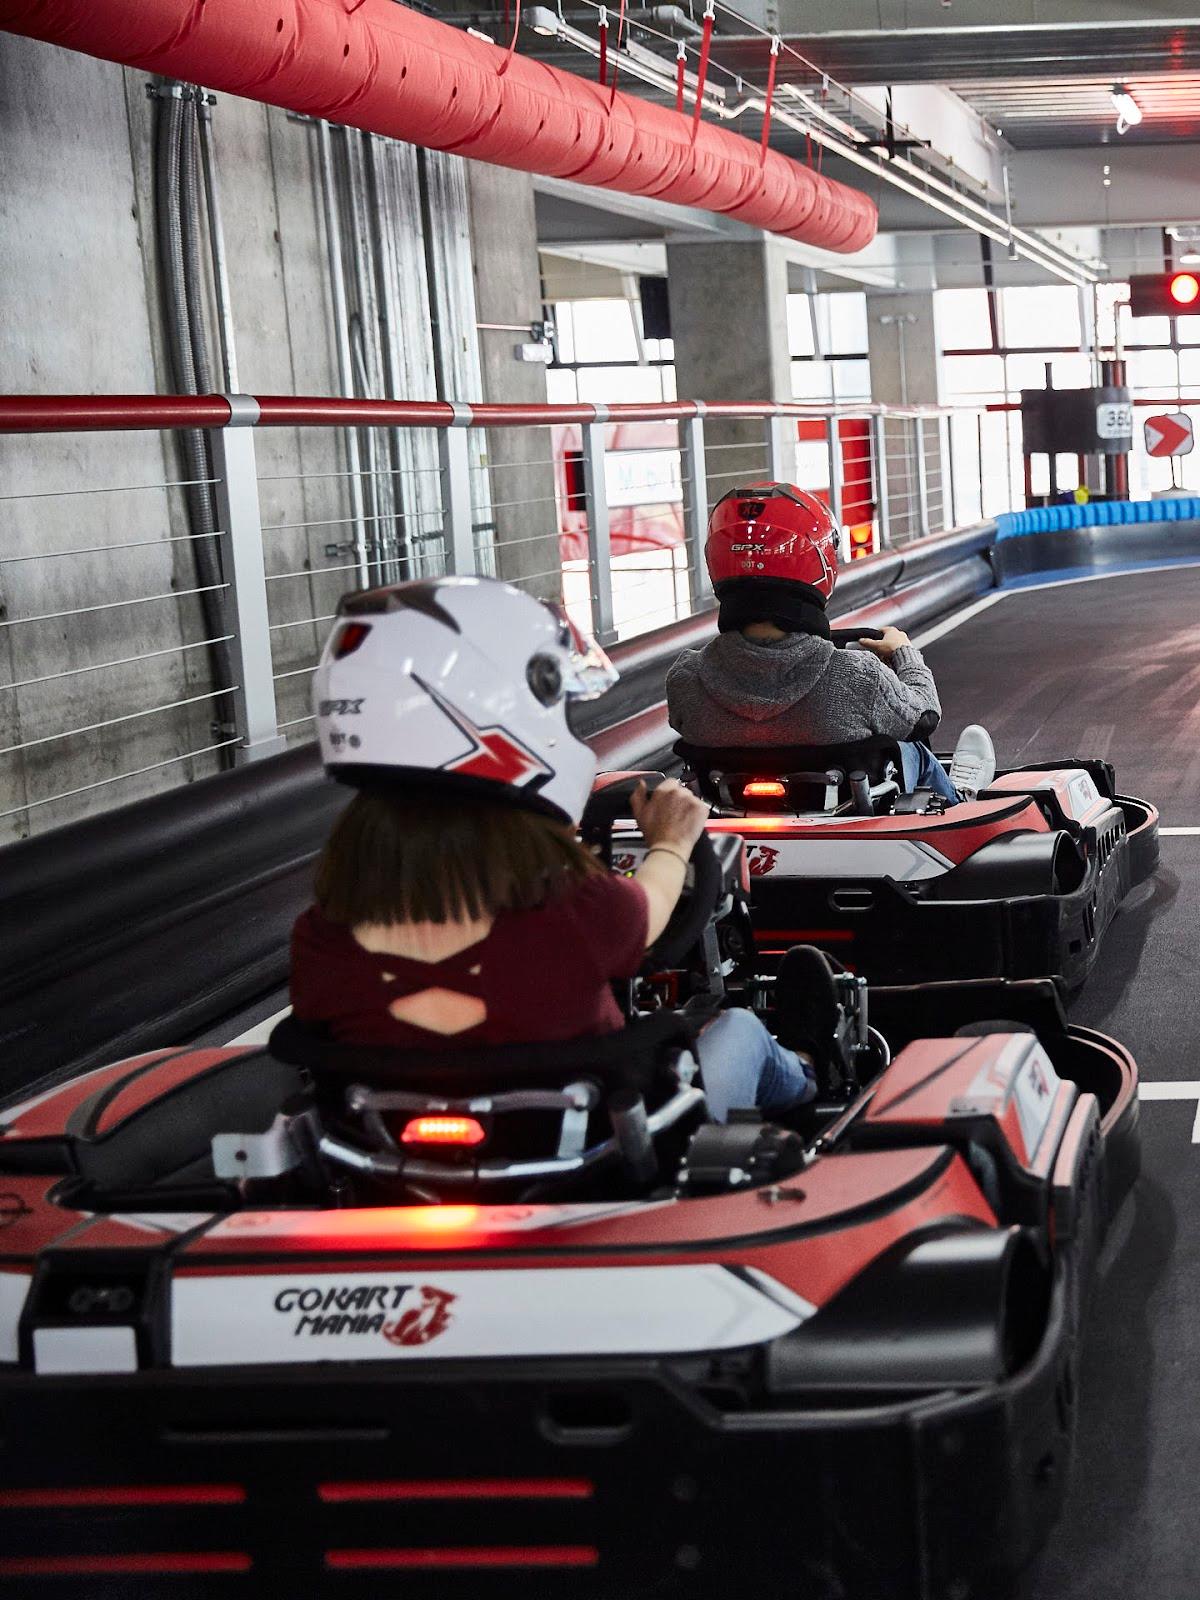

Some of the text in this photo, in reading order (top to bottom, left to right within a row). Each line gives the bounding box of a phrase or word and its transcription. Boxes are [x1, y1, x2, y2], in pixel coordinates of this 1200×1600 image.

[730, 543, 764, 553] GPX
[274, 1285, 414, 1312] GOKART
[295, 1313, 385, 1336] MANIA
